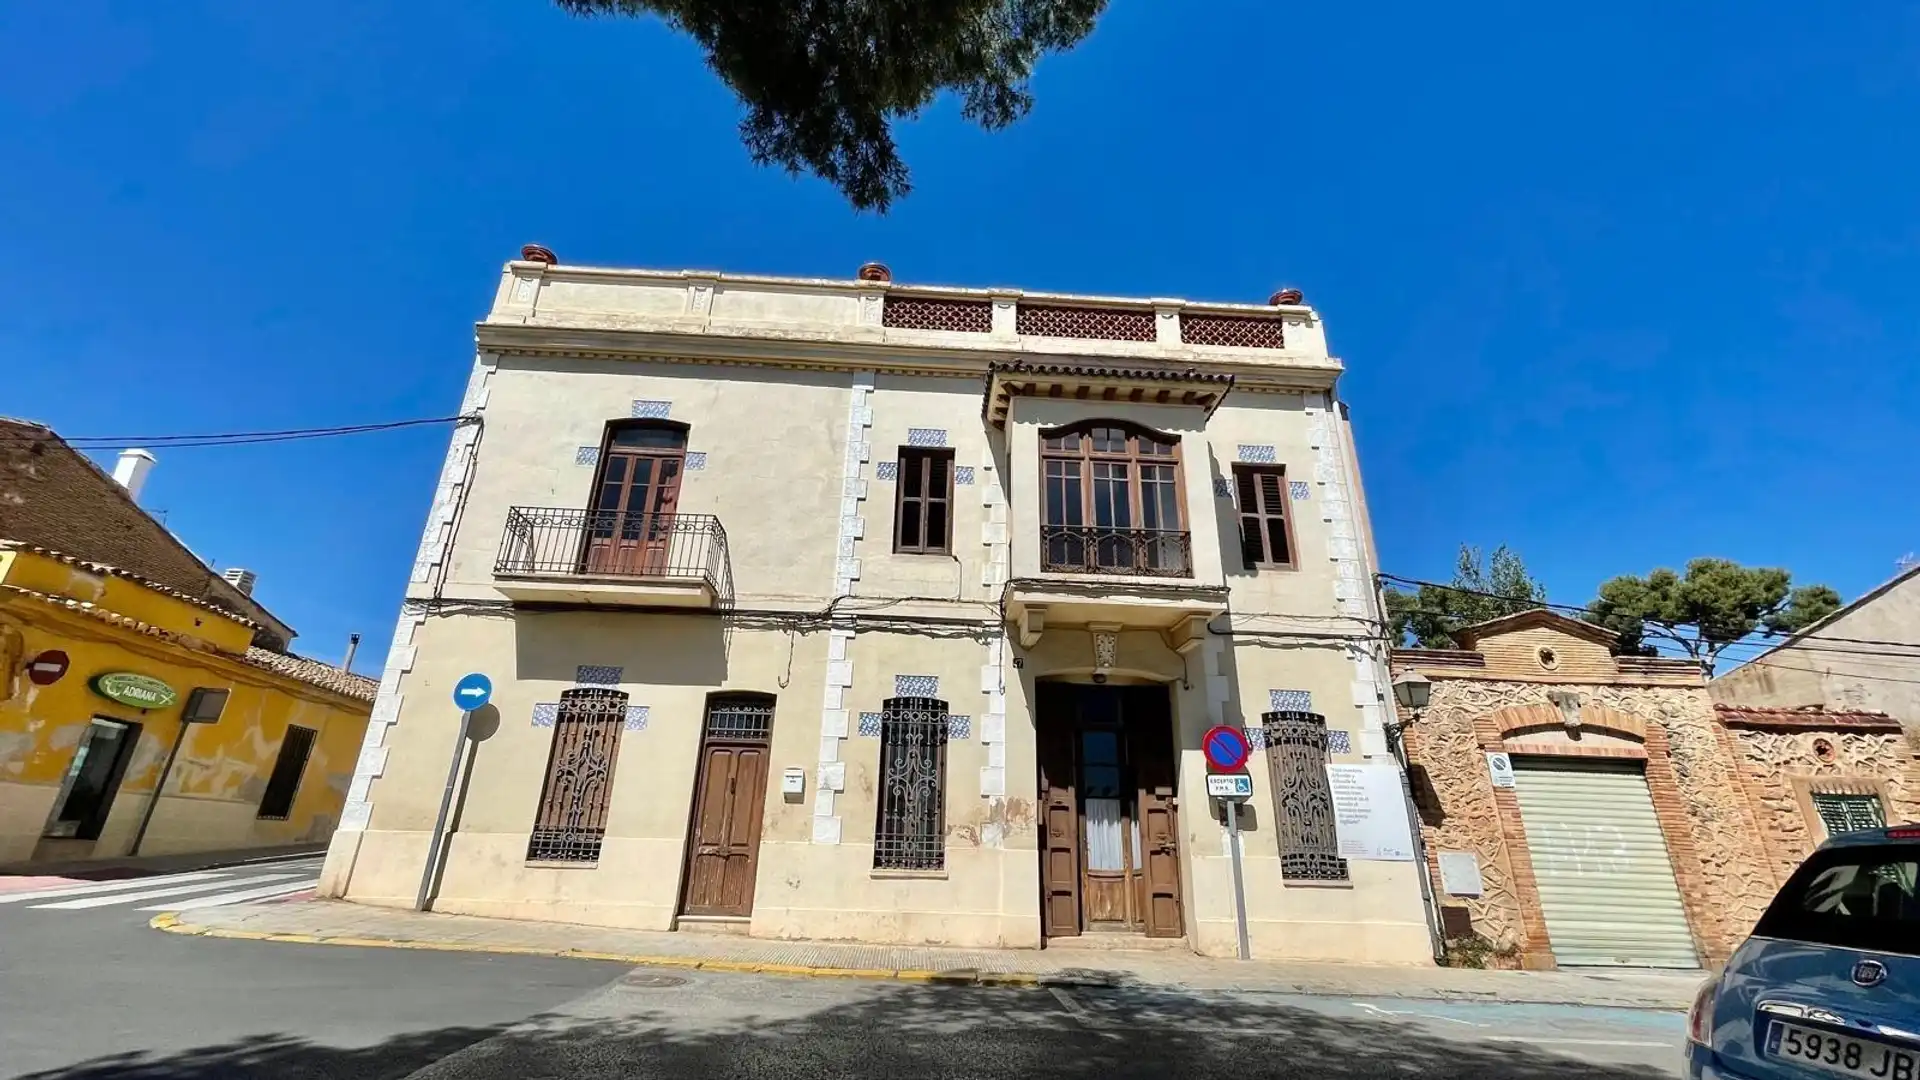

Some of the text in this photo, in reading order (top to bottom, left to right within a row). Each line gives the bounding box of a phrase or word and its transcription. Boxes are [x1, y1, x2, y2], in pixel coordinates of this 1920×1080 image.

[123, 684, 157, 701] ADRIANA
[1785, 1029, 1920, 1080] 5938 JB
